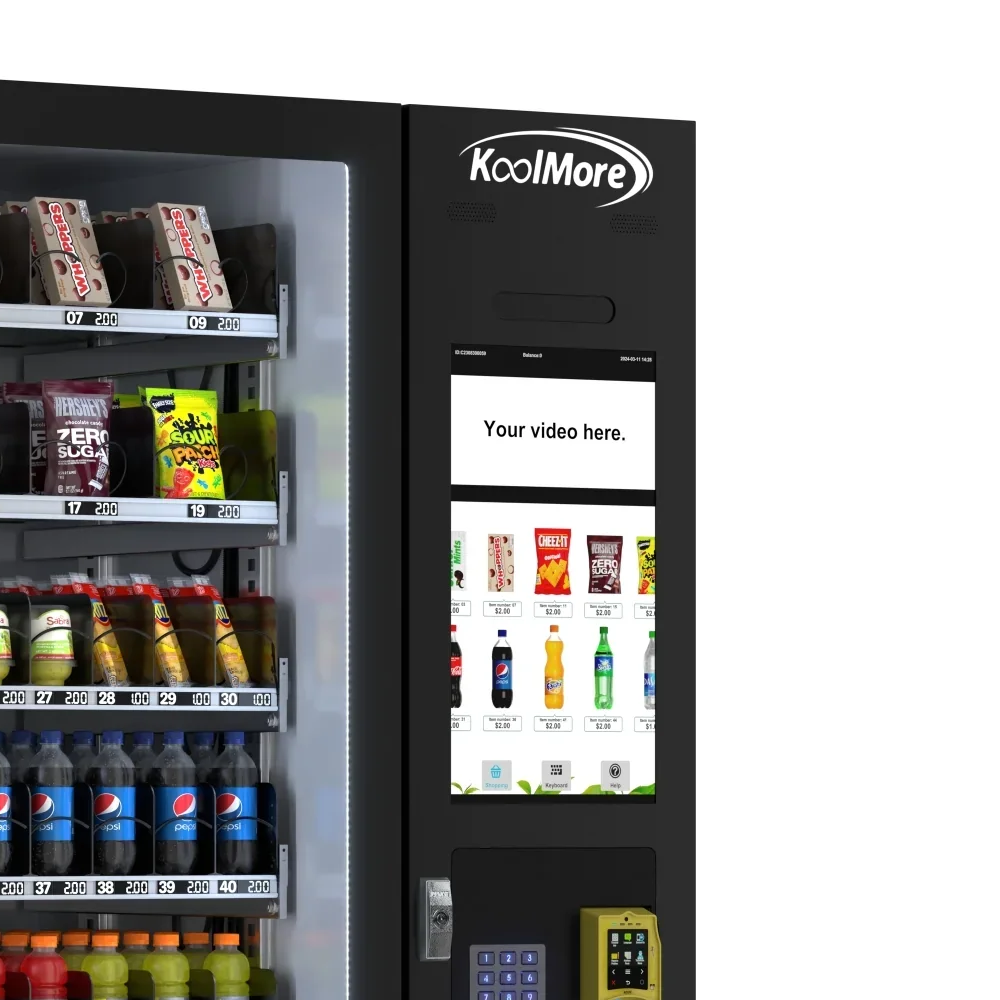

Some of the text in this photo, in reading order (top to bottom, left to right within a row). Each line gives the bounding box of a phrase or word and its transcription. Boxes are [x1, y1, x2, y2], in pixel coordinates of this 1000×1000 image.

[470, 147, 626, 189] KoolMore
[66, 311, 117, 325] 07 2.00
[189, 316, 240, 330] 09 2.00
[55, 397, 108, 418] HERSHEY'S
[170, 428, 215, 445] SOUR
[483, 420, 626, 441] Your video here.
[57, 428, 109, 447] ZERO
[67, 501, 117, 515] 17 2.00
[190, 504, 239, 517] 19 2.00
[538, 535, 568, 548] CHEEZ-IT
[591, 543, 618, 555] HERSHEY'S
[591, 560, 618, 568] ZERO
[495, 607, 510, 615] $2.00
[545, 608, 561, 616] $2.00
[46, 615, 69, 626] Sabra
[2, 690, 24, 704] 2.00
[36, 690, 87, 704] 27 2.00
[98, 691, 149, 704] 28 1.00
[159, 692, 210, 705] 29 1.00
[220, 692, 270, 705] 30 1.00
[545, 722, 561, 730] $2.00
[1, 881, 23, 895] 2.00
[35, 881, 86, 894] 37 2.00
[97, 880, 147, 894] 38 2.00
[158, 880, 208, 893] 39 2.00
[219, 880, 269, 893] 40 2.00
[485, 954, 532, 963] 1 2 3
[527, 974, 533, 982] 6
